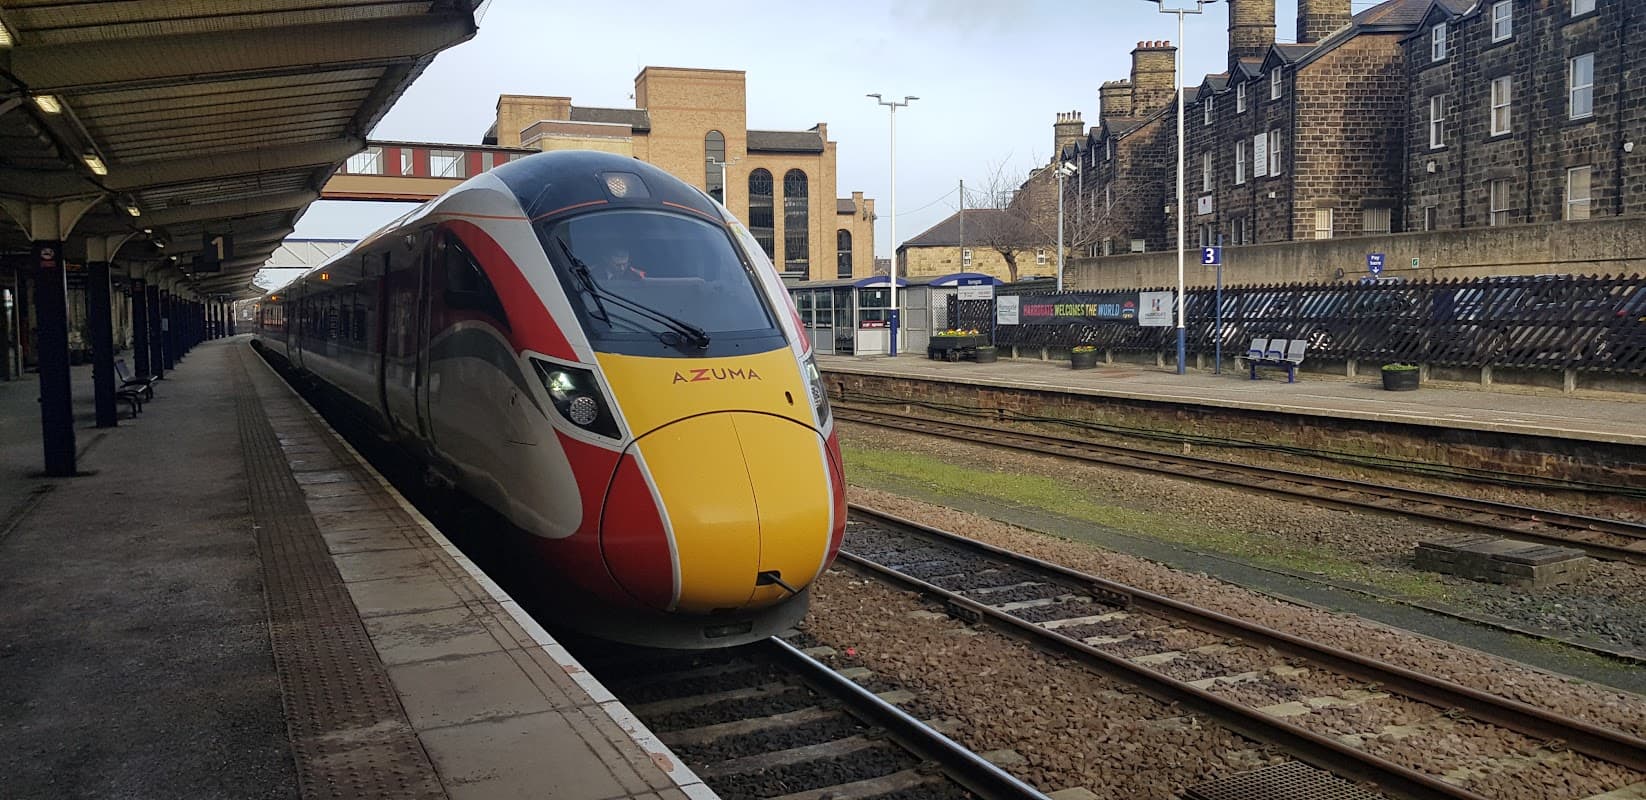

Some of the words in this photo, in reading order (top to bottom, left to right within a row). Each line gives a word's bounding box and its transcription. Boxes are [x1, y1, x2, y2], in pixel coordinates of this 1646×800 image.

[211, 236, 224, 260] 1
[1205, 248, 1214, 264] 3
[1024, 304, 1053, 316] HARROGATE
[1054, 304, 1084, 316] WELCOMES
[1085, 304, 1097, 316] THE
[1098, 304, 1120, 316] WORLD
[672, 368, 762, 384] AZUMA
